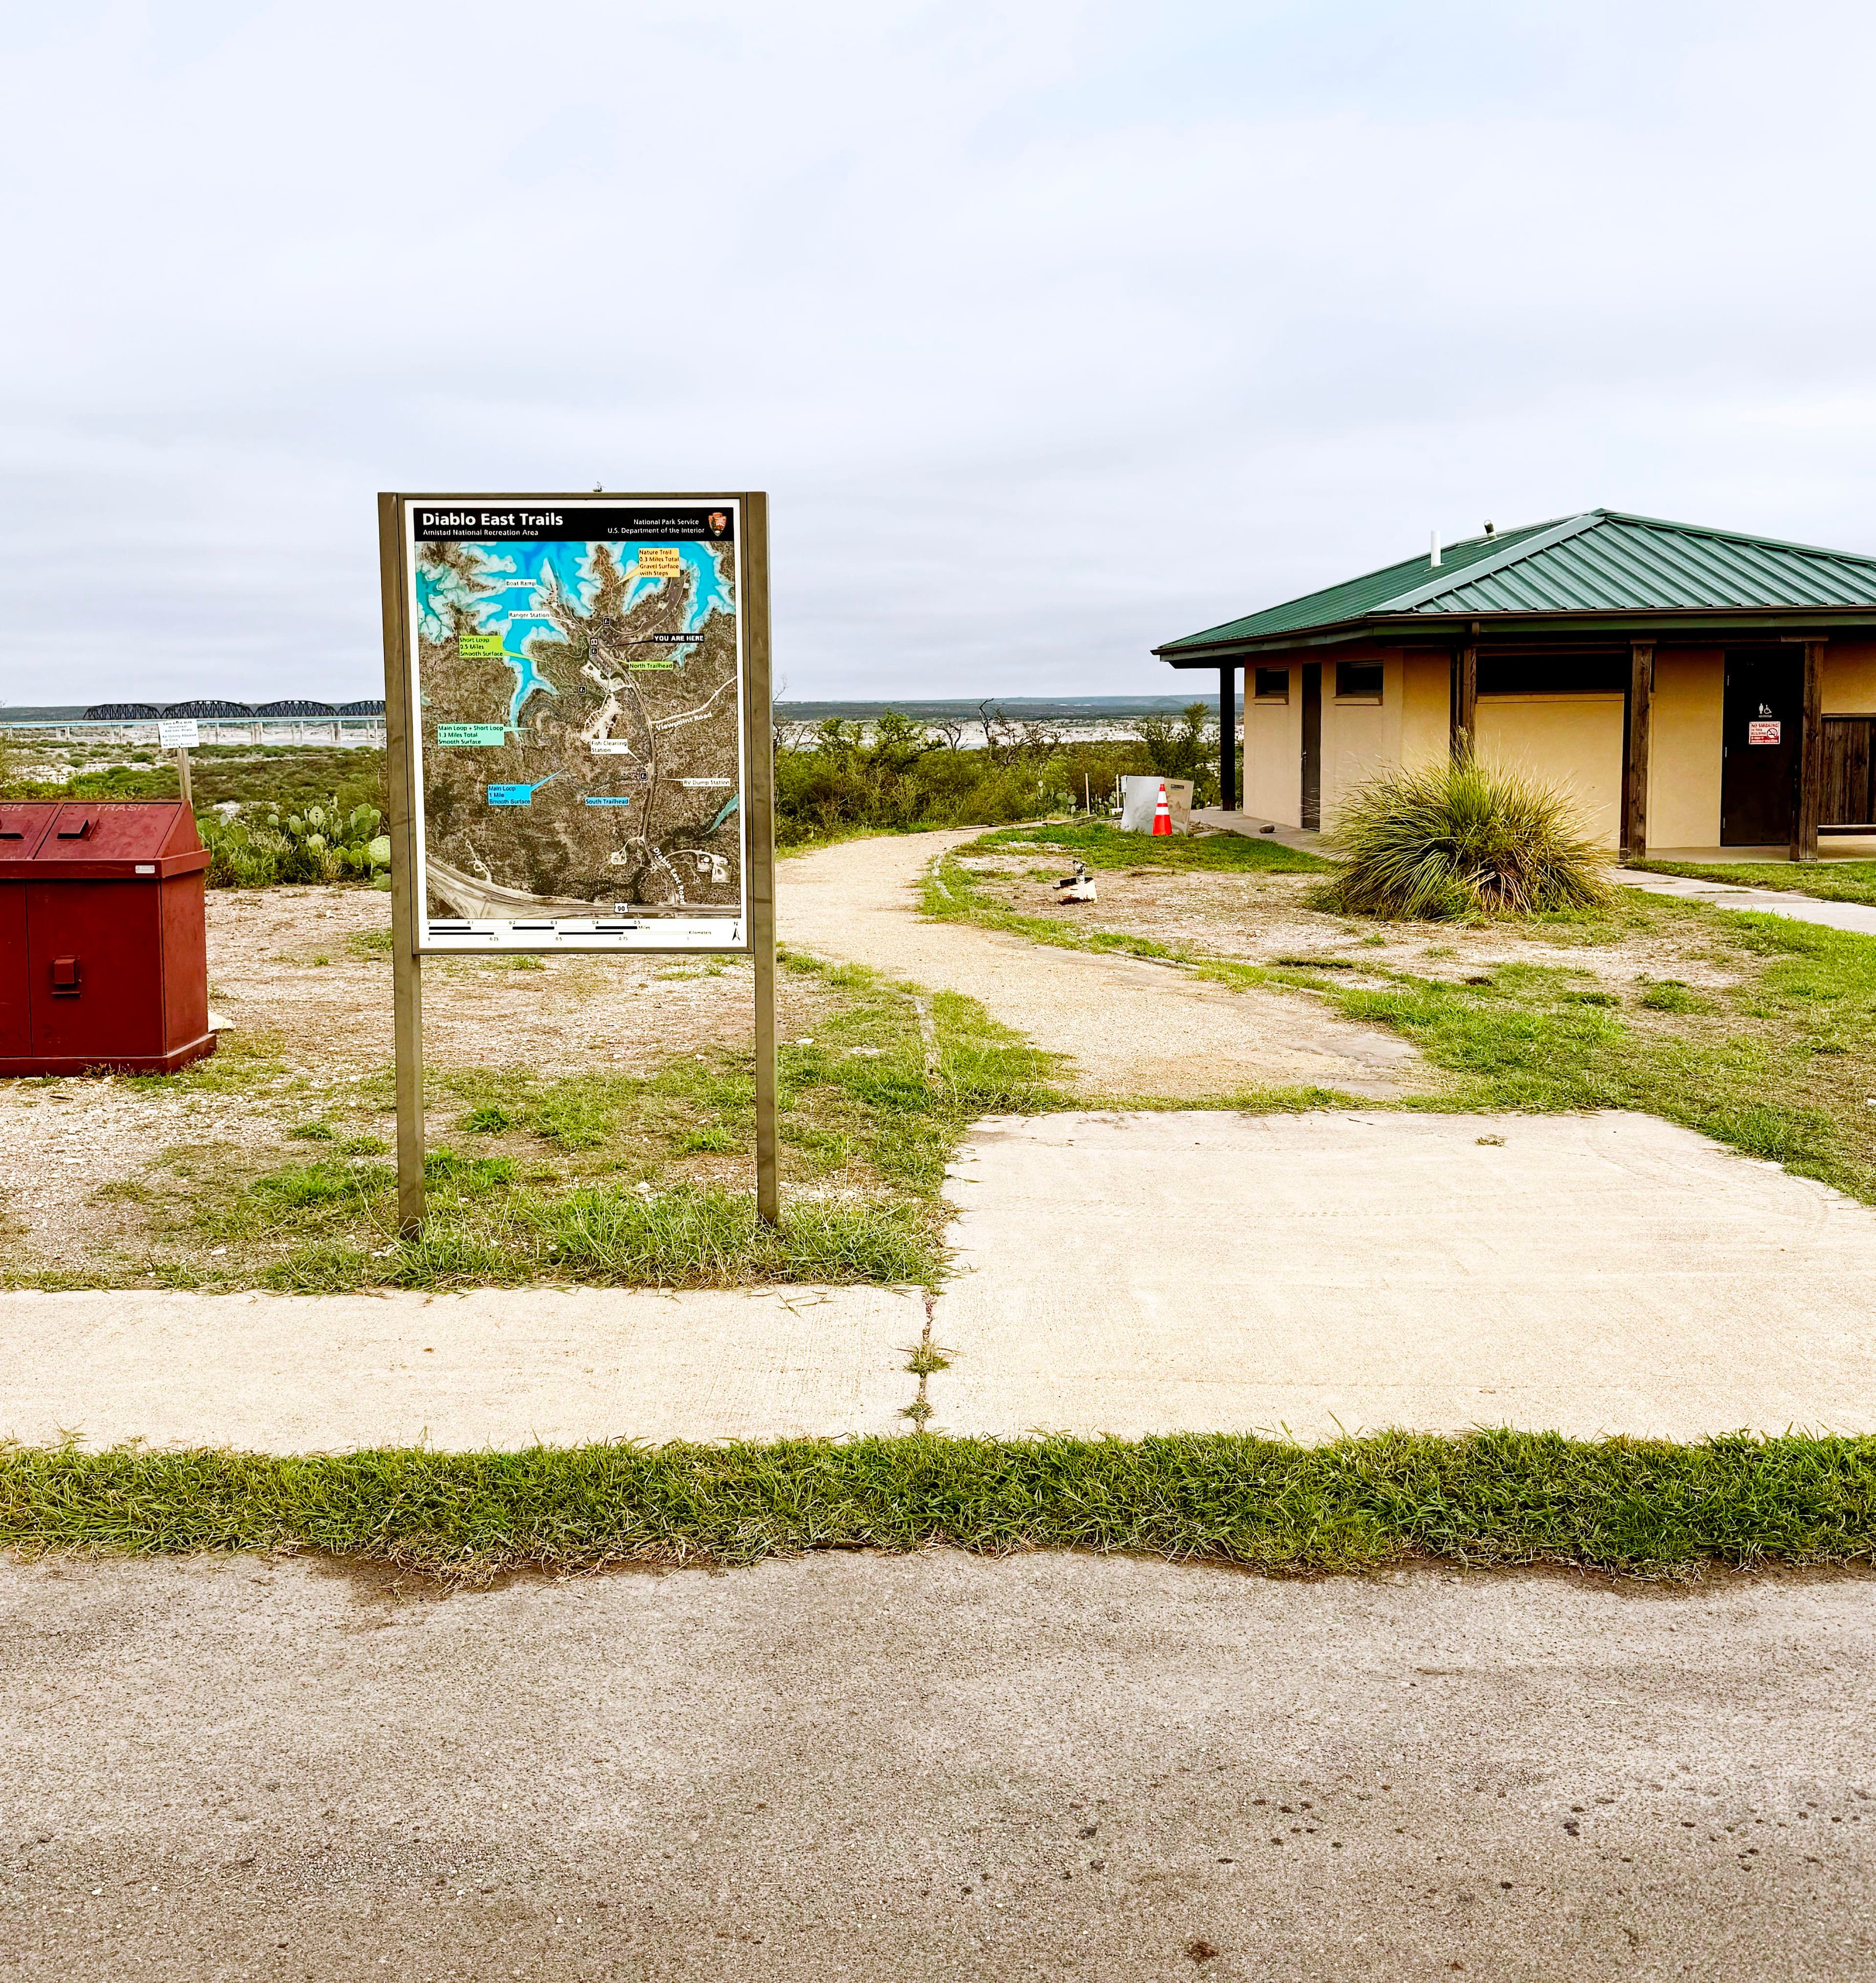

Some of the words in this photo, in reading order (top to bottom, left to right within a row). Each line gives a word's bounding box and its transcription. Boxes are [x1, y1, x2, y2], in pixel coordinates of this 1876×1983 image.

[423, 513, 476, 526] Diablo
[481, 513, 515, 526] East
[519, 513, 563, 526] Trails
[656, 717, 693, 731] Viewpoint
[694, 711, 712, 721] Road
[653, 847, 671, 869] Diablo
[670, 868, 681, 884] East
[678, 885, 686, 904] Road
